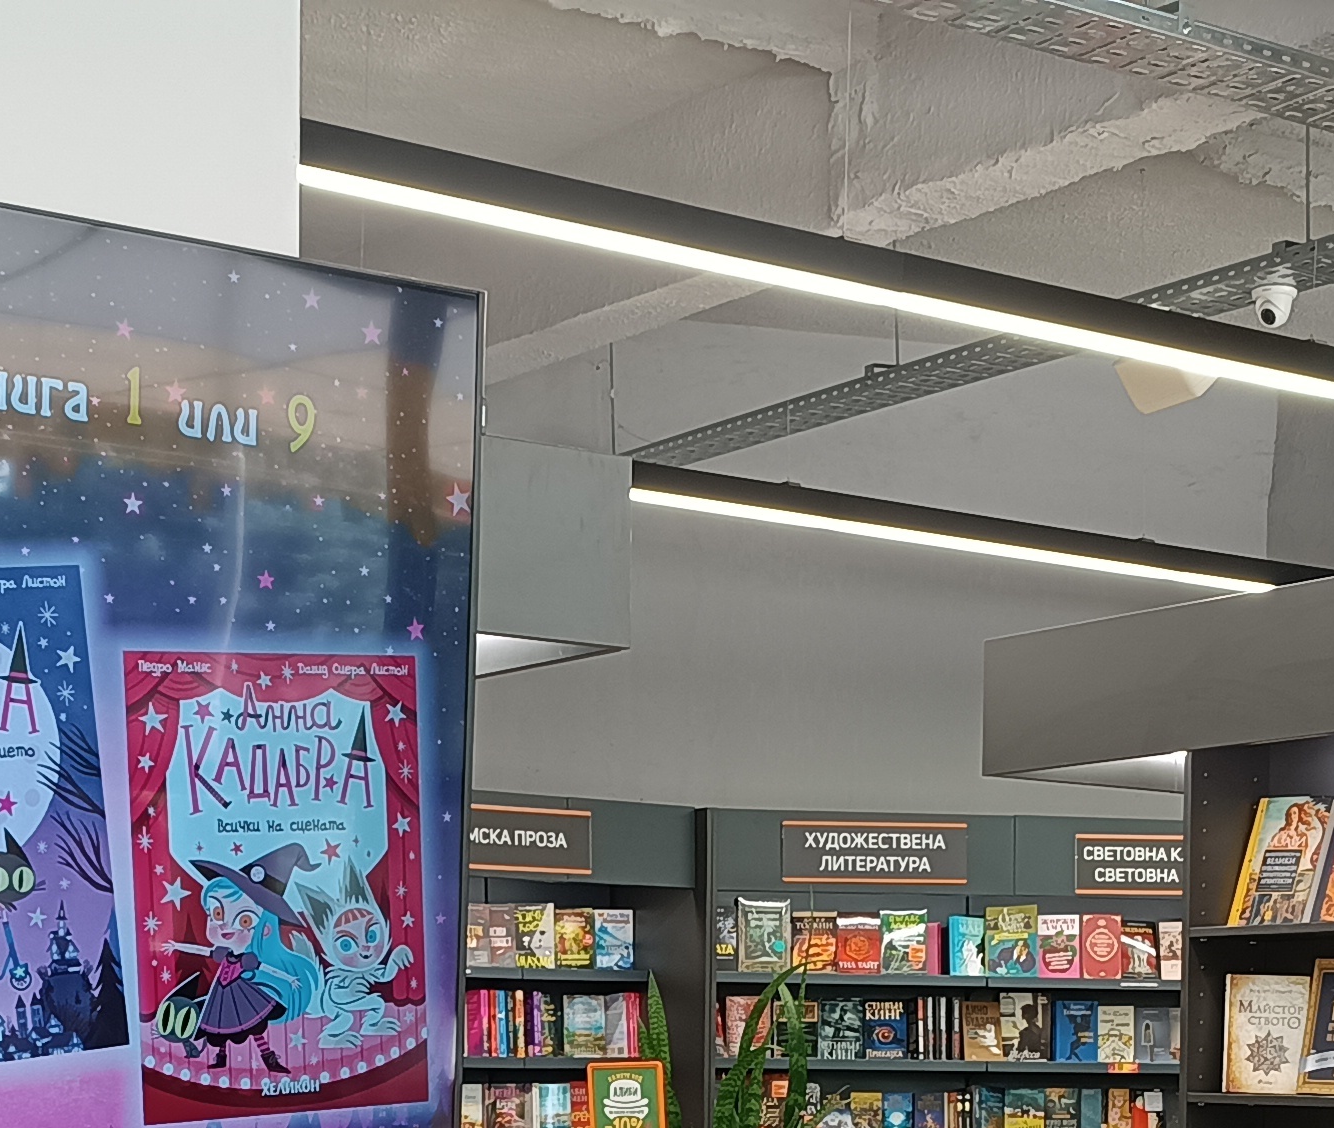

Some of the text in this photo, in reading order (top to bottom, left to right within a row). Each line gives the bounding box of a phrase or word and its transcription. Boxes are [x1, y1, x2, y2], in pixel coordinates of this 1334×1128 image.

[126, 366, 142, 426] 1
[178, 398, 258, 446] или
[287, 394, 316, 452] 9
[138, 660, 172, 674] Педро
[298, 663, 328, 677] Давид
[236, 682, 342, 732] Анна
[181, 705, 376, 815] КАДАБРА
[217, 819, 346, 833] Всички на сцената
[514, 830, 568, 849] ПРОЗА
[804, 831, 946, 851] ХУДОЖЕСТВЕНА
[1083, 846, 1168, 862] СВЕТОВНА
[819, 855, 931, 873] ЛИТЕРАТУРА
[1094, 867, 1179, 883] СВЕТОВНА
[865, 1010, 904, 1020] КИНГ
[1238, 999, 1305, 1017] МАЙСТОР
[1247, 1014, 1302, 1030] СТВОТО
[261, 1077, 320, 1097] ХЕЛИКОН
